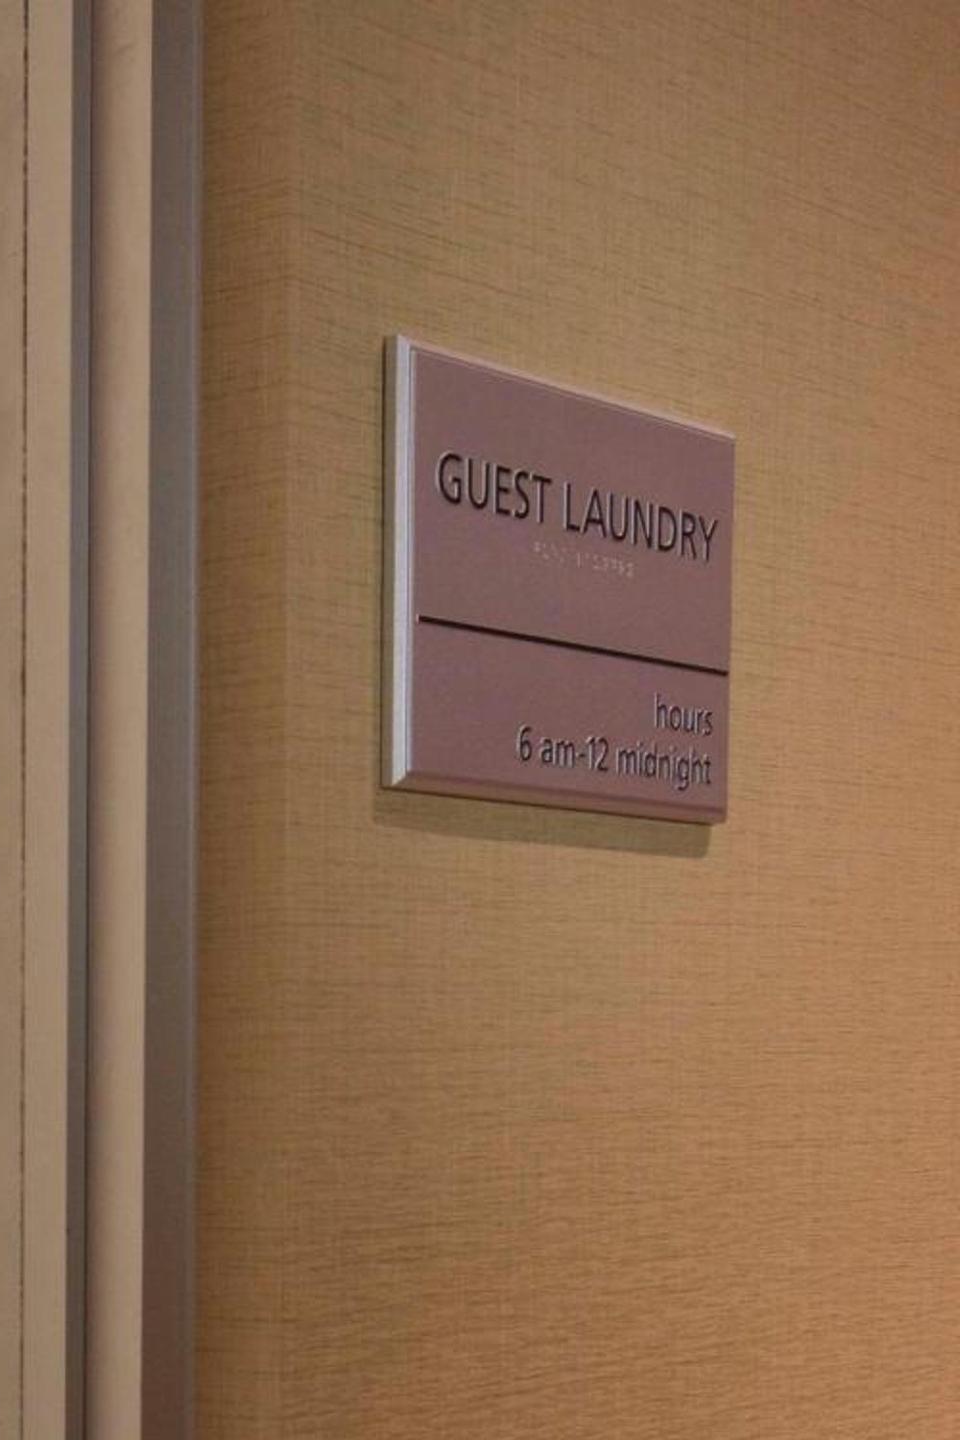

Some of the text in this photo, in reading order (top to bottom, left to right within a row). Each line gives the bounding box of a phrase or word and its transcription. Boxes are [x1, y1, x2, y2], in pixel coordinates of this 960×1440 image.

[435, 452, 718, 562] GUEST LAUNDRY
[654, 692, 713, 736] hours
[516, 722, 533, 762] 6
[615, 742, 711, 791] midnight
